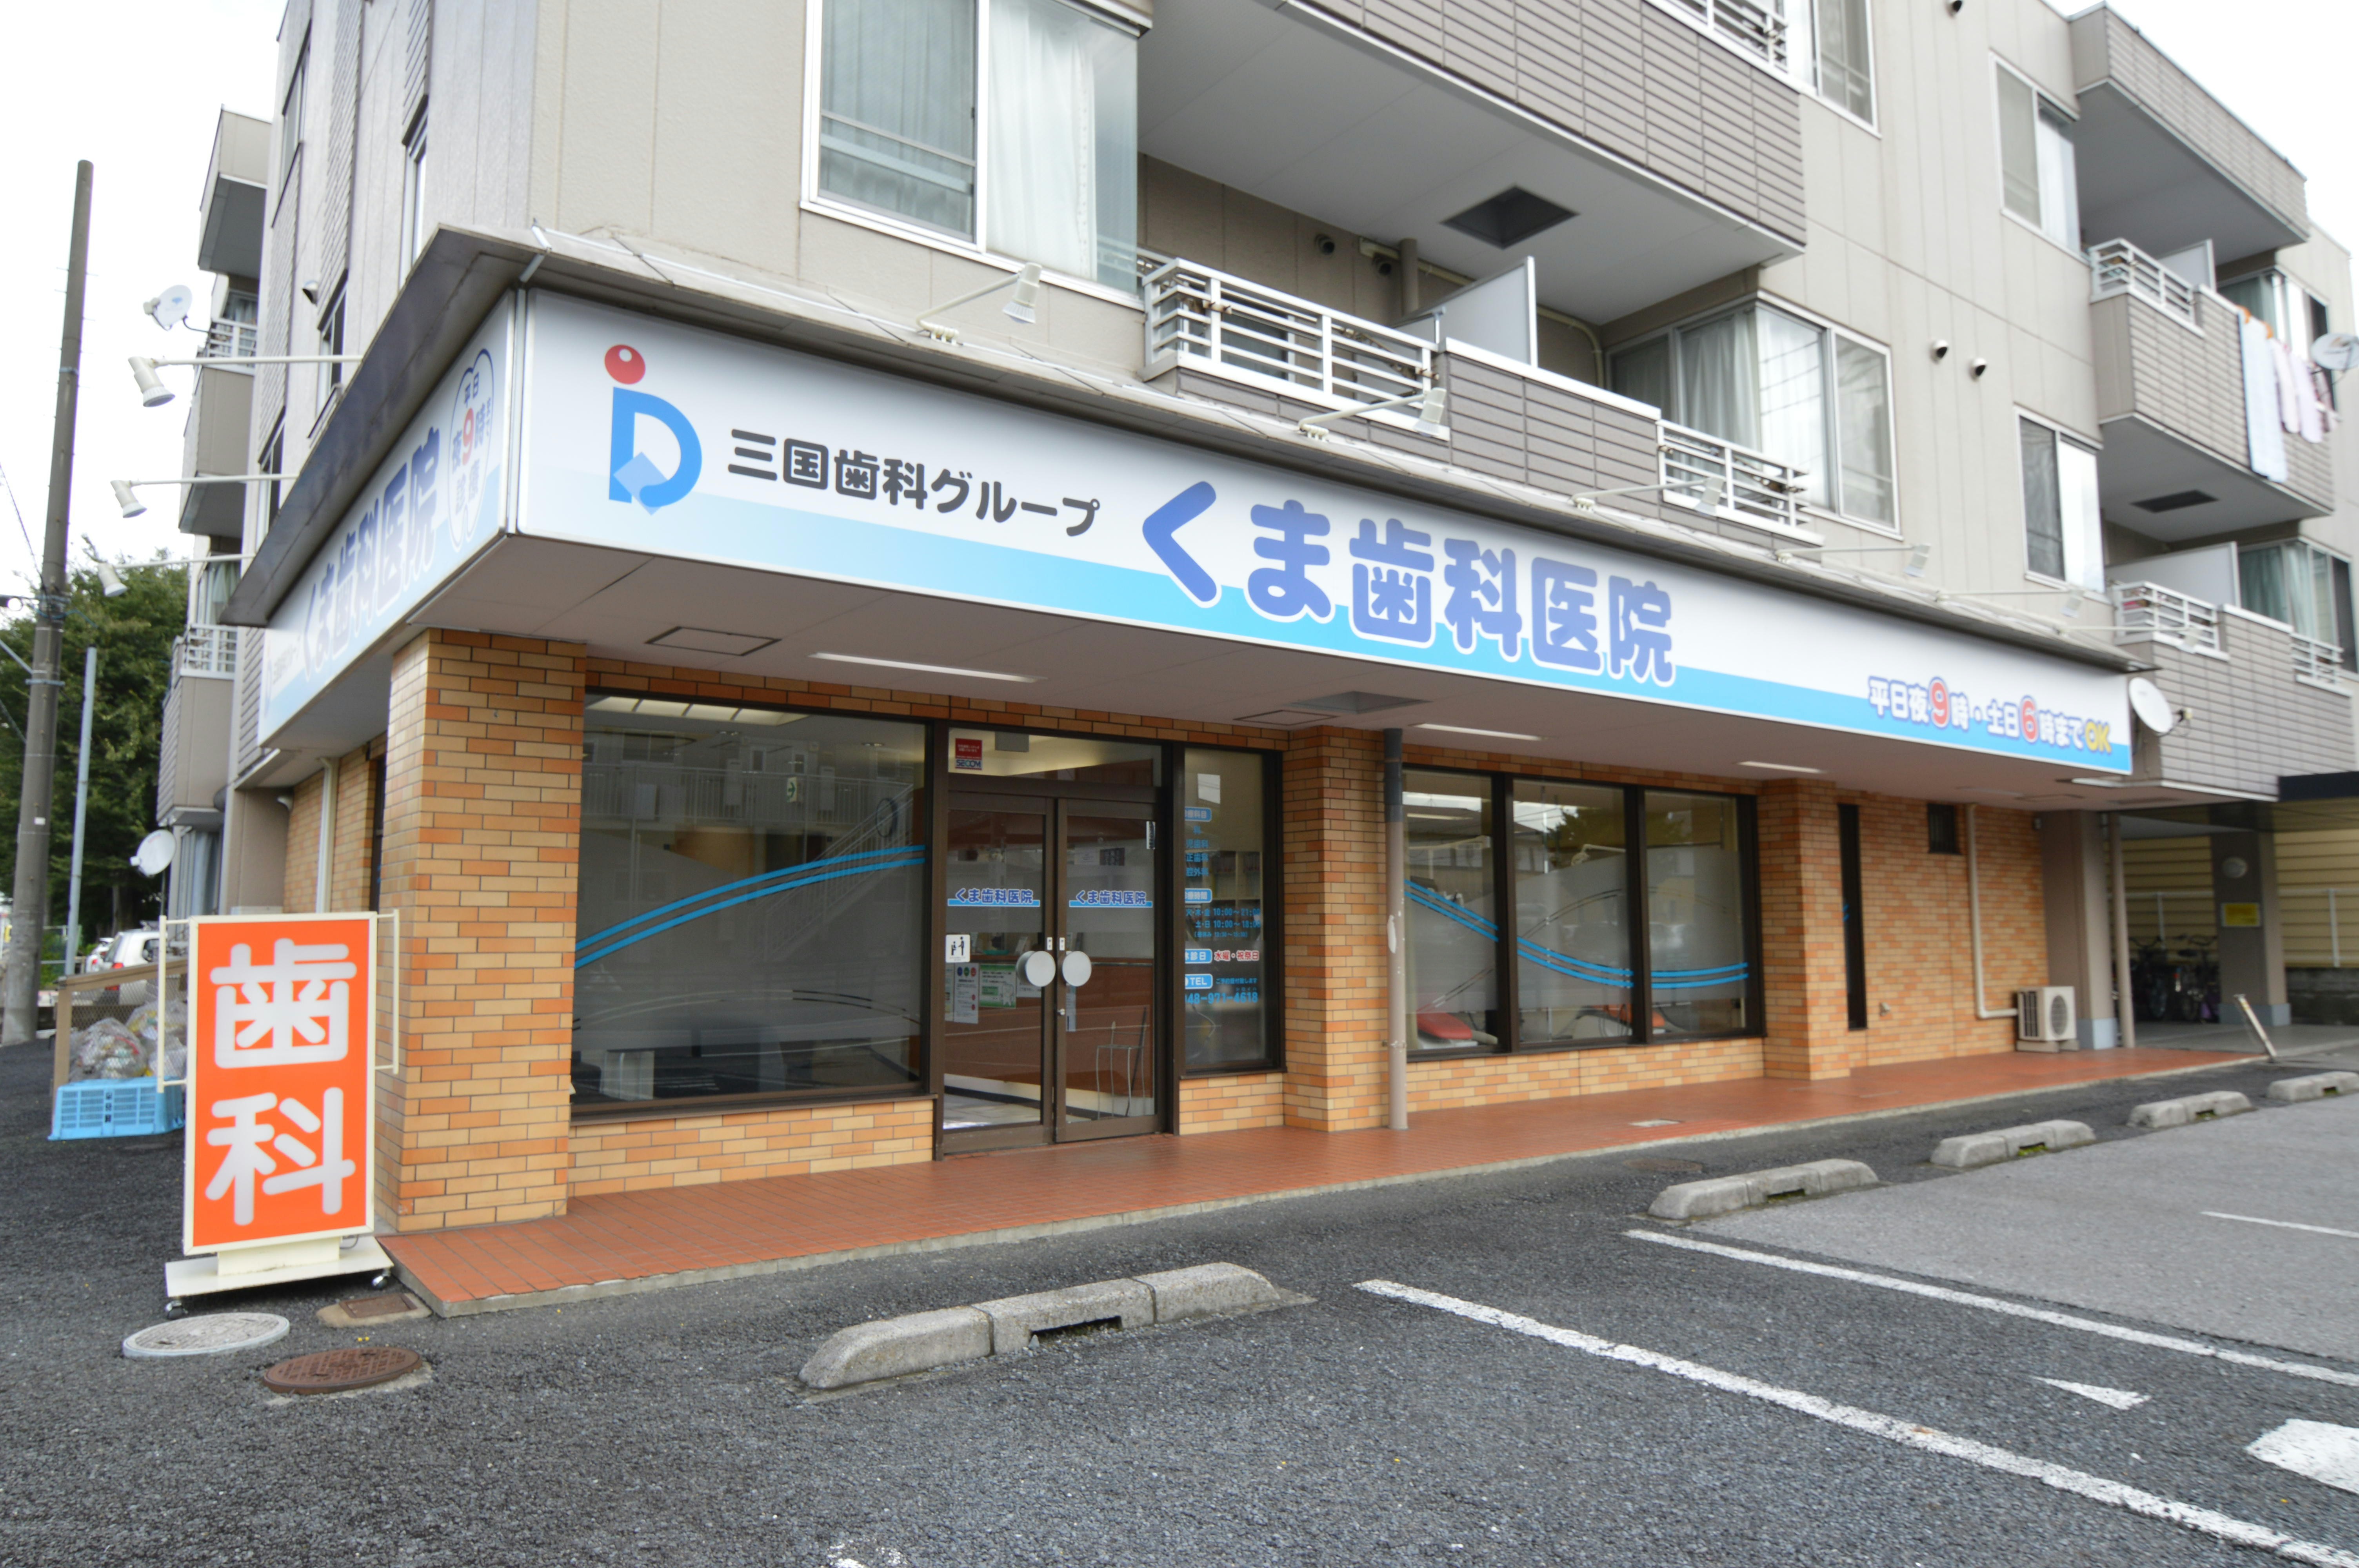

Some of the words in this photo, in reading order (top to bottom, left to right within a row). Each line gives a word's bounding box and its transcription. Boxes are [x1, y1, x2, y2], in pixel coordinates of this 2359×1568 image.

[727, 428, 1101, 538] 三国歯科グループ
[304, 426, 440, 681] くま歯科医院
[1141, 480, 1674, 684] くま歯科医院
[956, 759, 981, 768] SECOM
[955, 888, 1033, 904] くま歯科医院
[1076, 890, 1146, 905] くま歯科医院
[1190, 977, 1207, 985] TEL
[1185, 992, 1259, 1004] 48-971-4618
[205, 937, 358, 1226] 歯科
